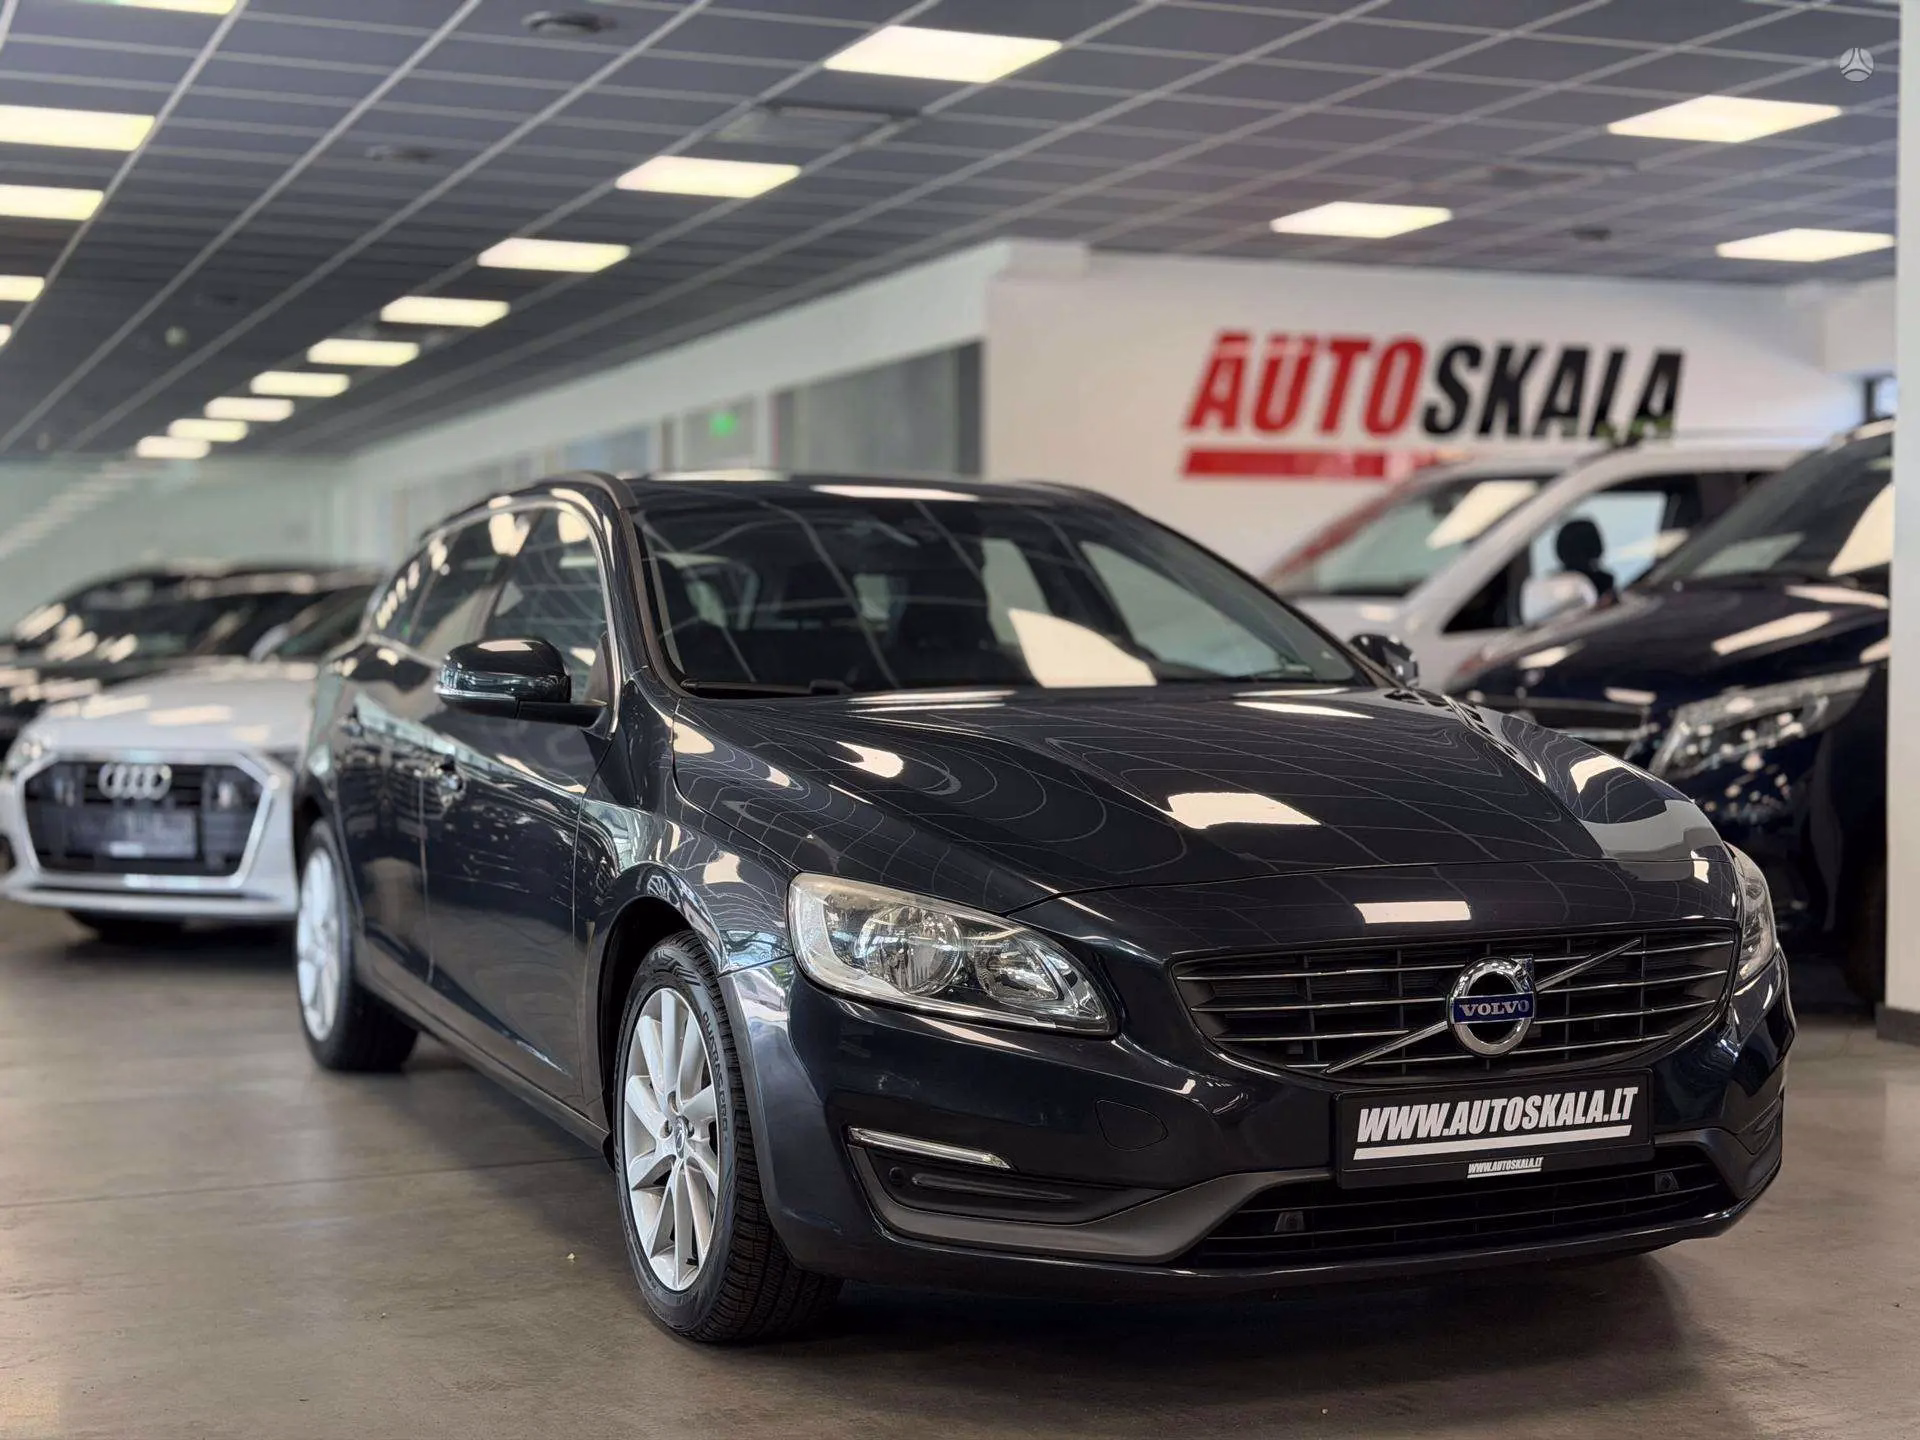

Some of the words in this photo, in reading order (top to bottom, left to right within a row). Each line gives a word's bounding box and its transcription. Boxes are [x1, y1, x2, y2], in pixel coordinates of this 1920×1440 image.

[1459, 1000, 1529, 1016] VOLVO
[1357, 1087, 1638, 1142] WWW.AUTOSKALA.LT
[1467, 1157, 1544, 1174] WWW.AUTOSKALA.LT
